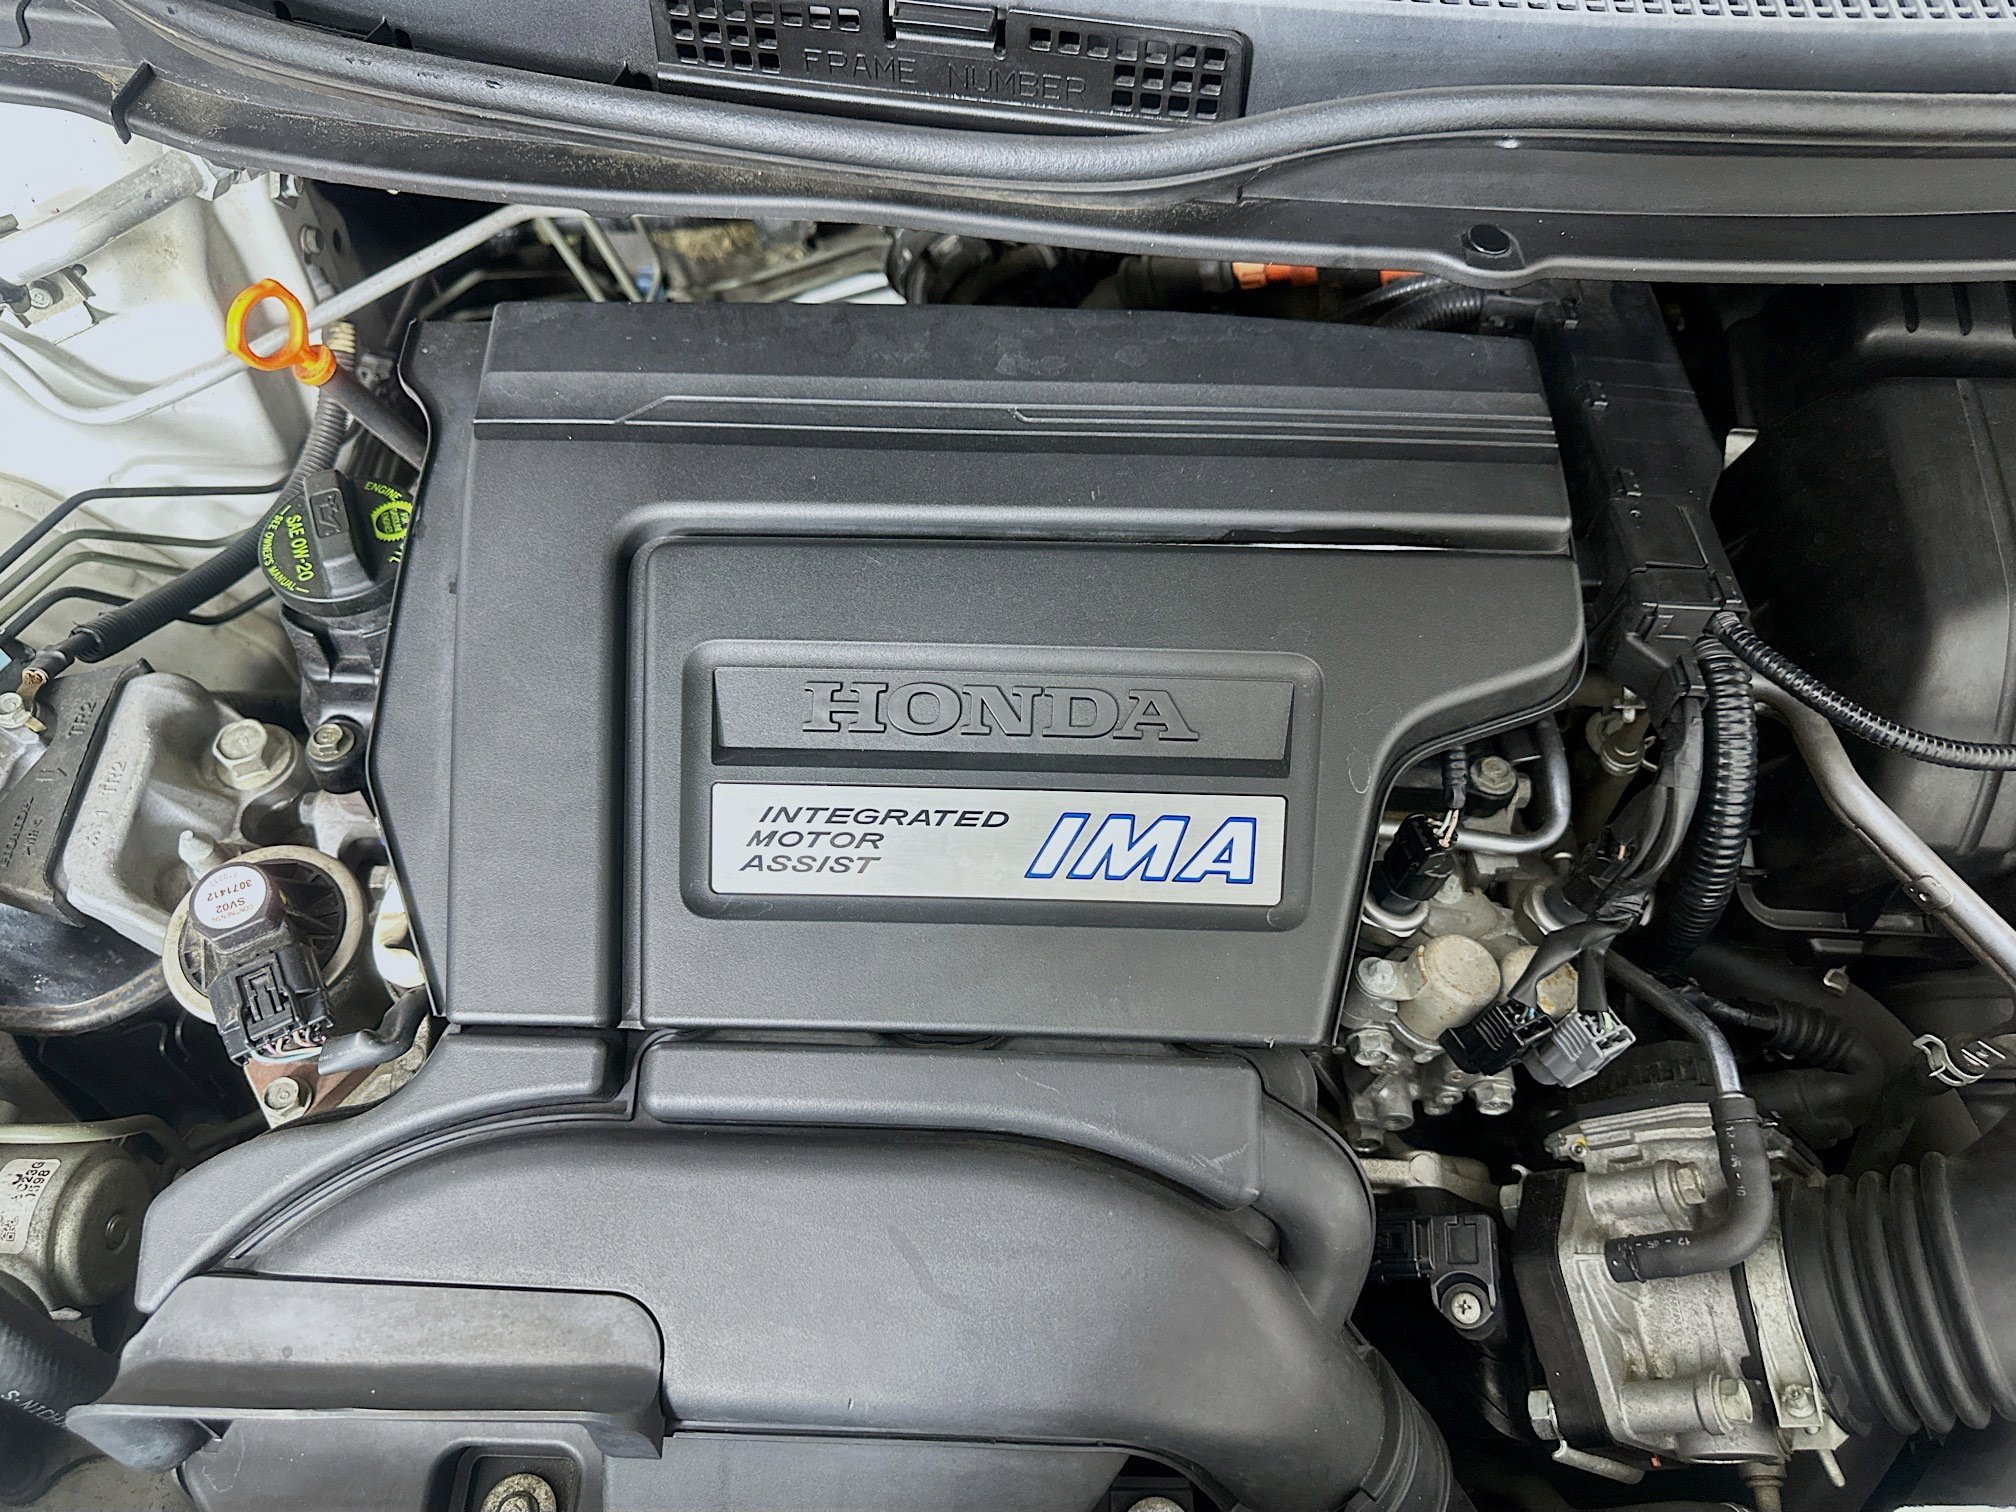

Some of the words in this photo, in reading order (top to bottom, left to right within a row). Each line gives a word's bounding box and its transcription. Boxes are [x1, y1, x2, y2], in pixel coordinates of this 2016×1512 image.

[804, 48, 917, 84] FRAME
[948, 63, 1087, 102] NUMBER
[364, 481, 403, 501] ENGINE
[267, 514, 284, 531] SEE
[286, 514, 305, 539] SAE
[267, 565, 297, 592] MANUAL
[802, 681, 1200, 742] HONDA
[757, 805, 1010, 828] INTEGRATED
[745, 830, 885, 850] MOTOR
[1024, 812, 1258, 884] IMA
[739, 854, 882, 874] ASSIST
[207, 879, 253, 902] 3071412
[215, 897, 246, 914] SV02
